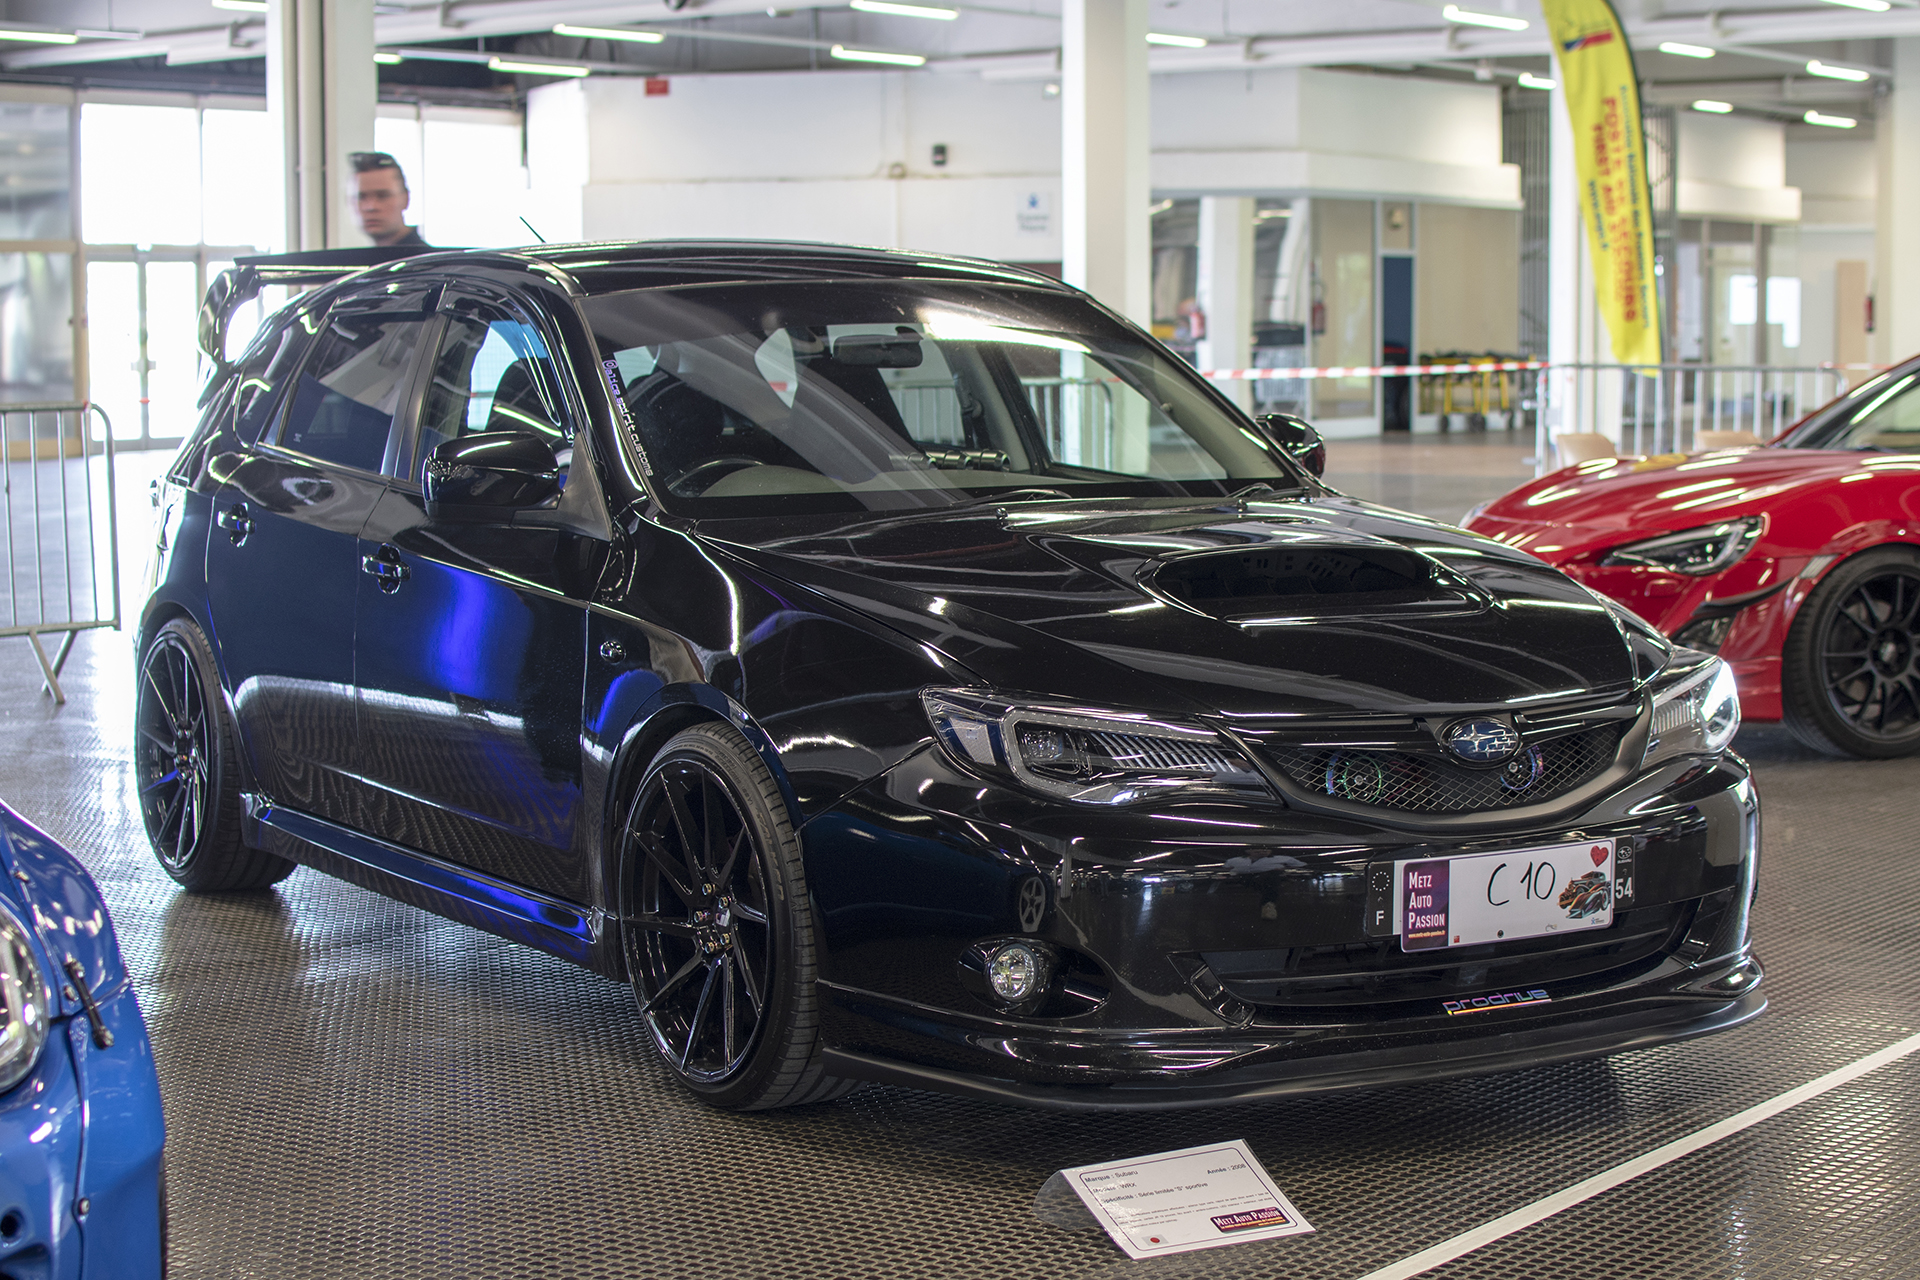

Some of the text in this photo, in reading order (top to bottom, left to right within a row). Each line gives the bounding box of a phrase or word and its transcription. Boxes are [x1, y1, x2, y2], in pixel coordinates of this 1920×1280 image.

[1486, 860, 1556, 907] C 10
[1615, 876, 1633, 900] 54
[1375, 909, 1385, 926] F
[1442, 989, 1550, 1016] prodrive
[1084, 1175, 1111, 1184] Marque
[1114, 1170, 1139, 1178] Subaru
